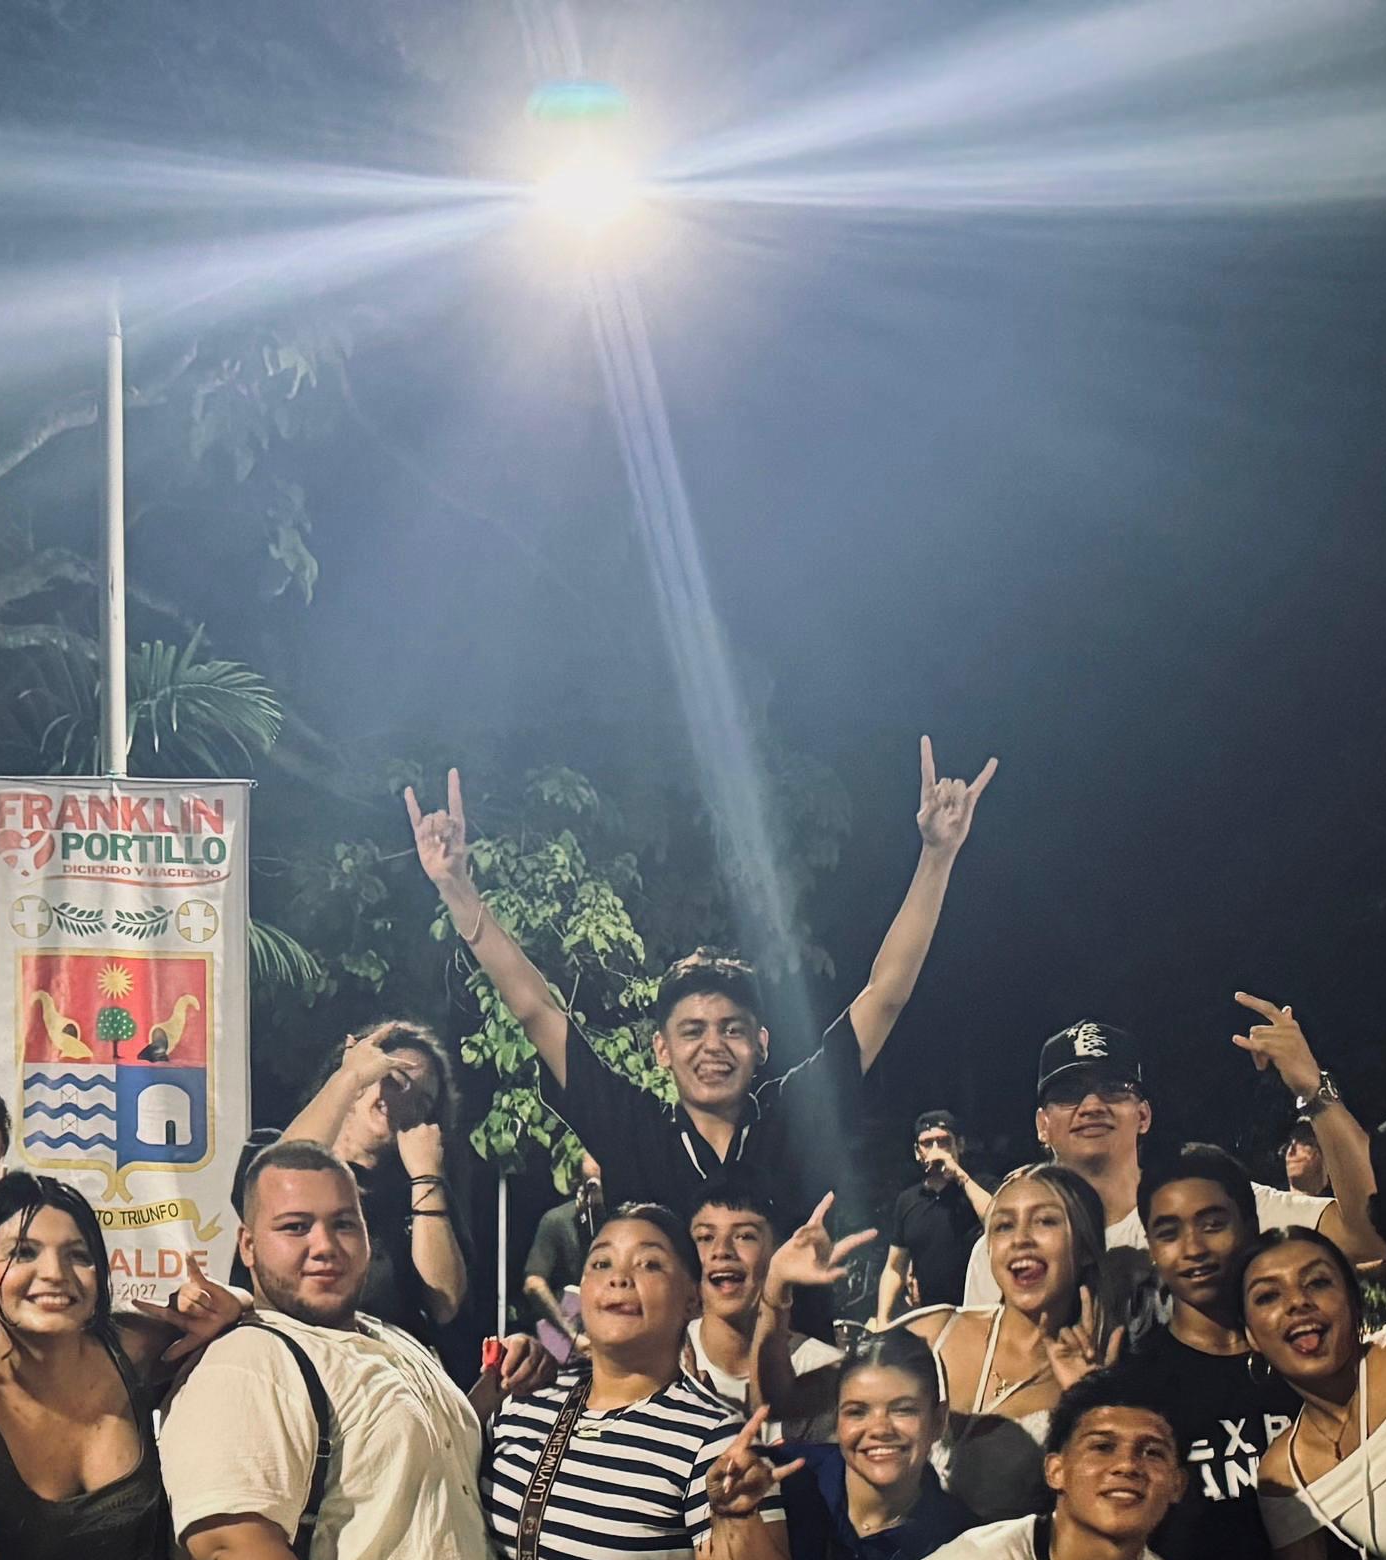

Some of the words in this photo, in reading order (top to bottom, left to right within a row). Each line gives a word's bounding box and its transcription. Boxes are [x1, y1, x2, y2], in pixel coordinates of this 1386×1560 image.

[61, 832, 227, 866] PORTILLO
[62, 864, 131, 876] DICIENDO
[134, 866, 144, 877] Y
[147, 867, 222, 879] HACIENDO
[93, 1209, 114, 1226] TO
[120, 1202, 180, 1226] TRIUNFO
[109, 1248, 209, 1278] ALDE
[116, 1283, 157, 1301] -2027
